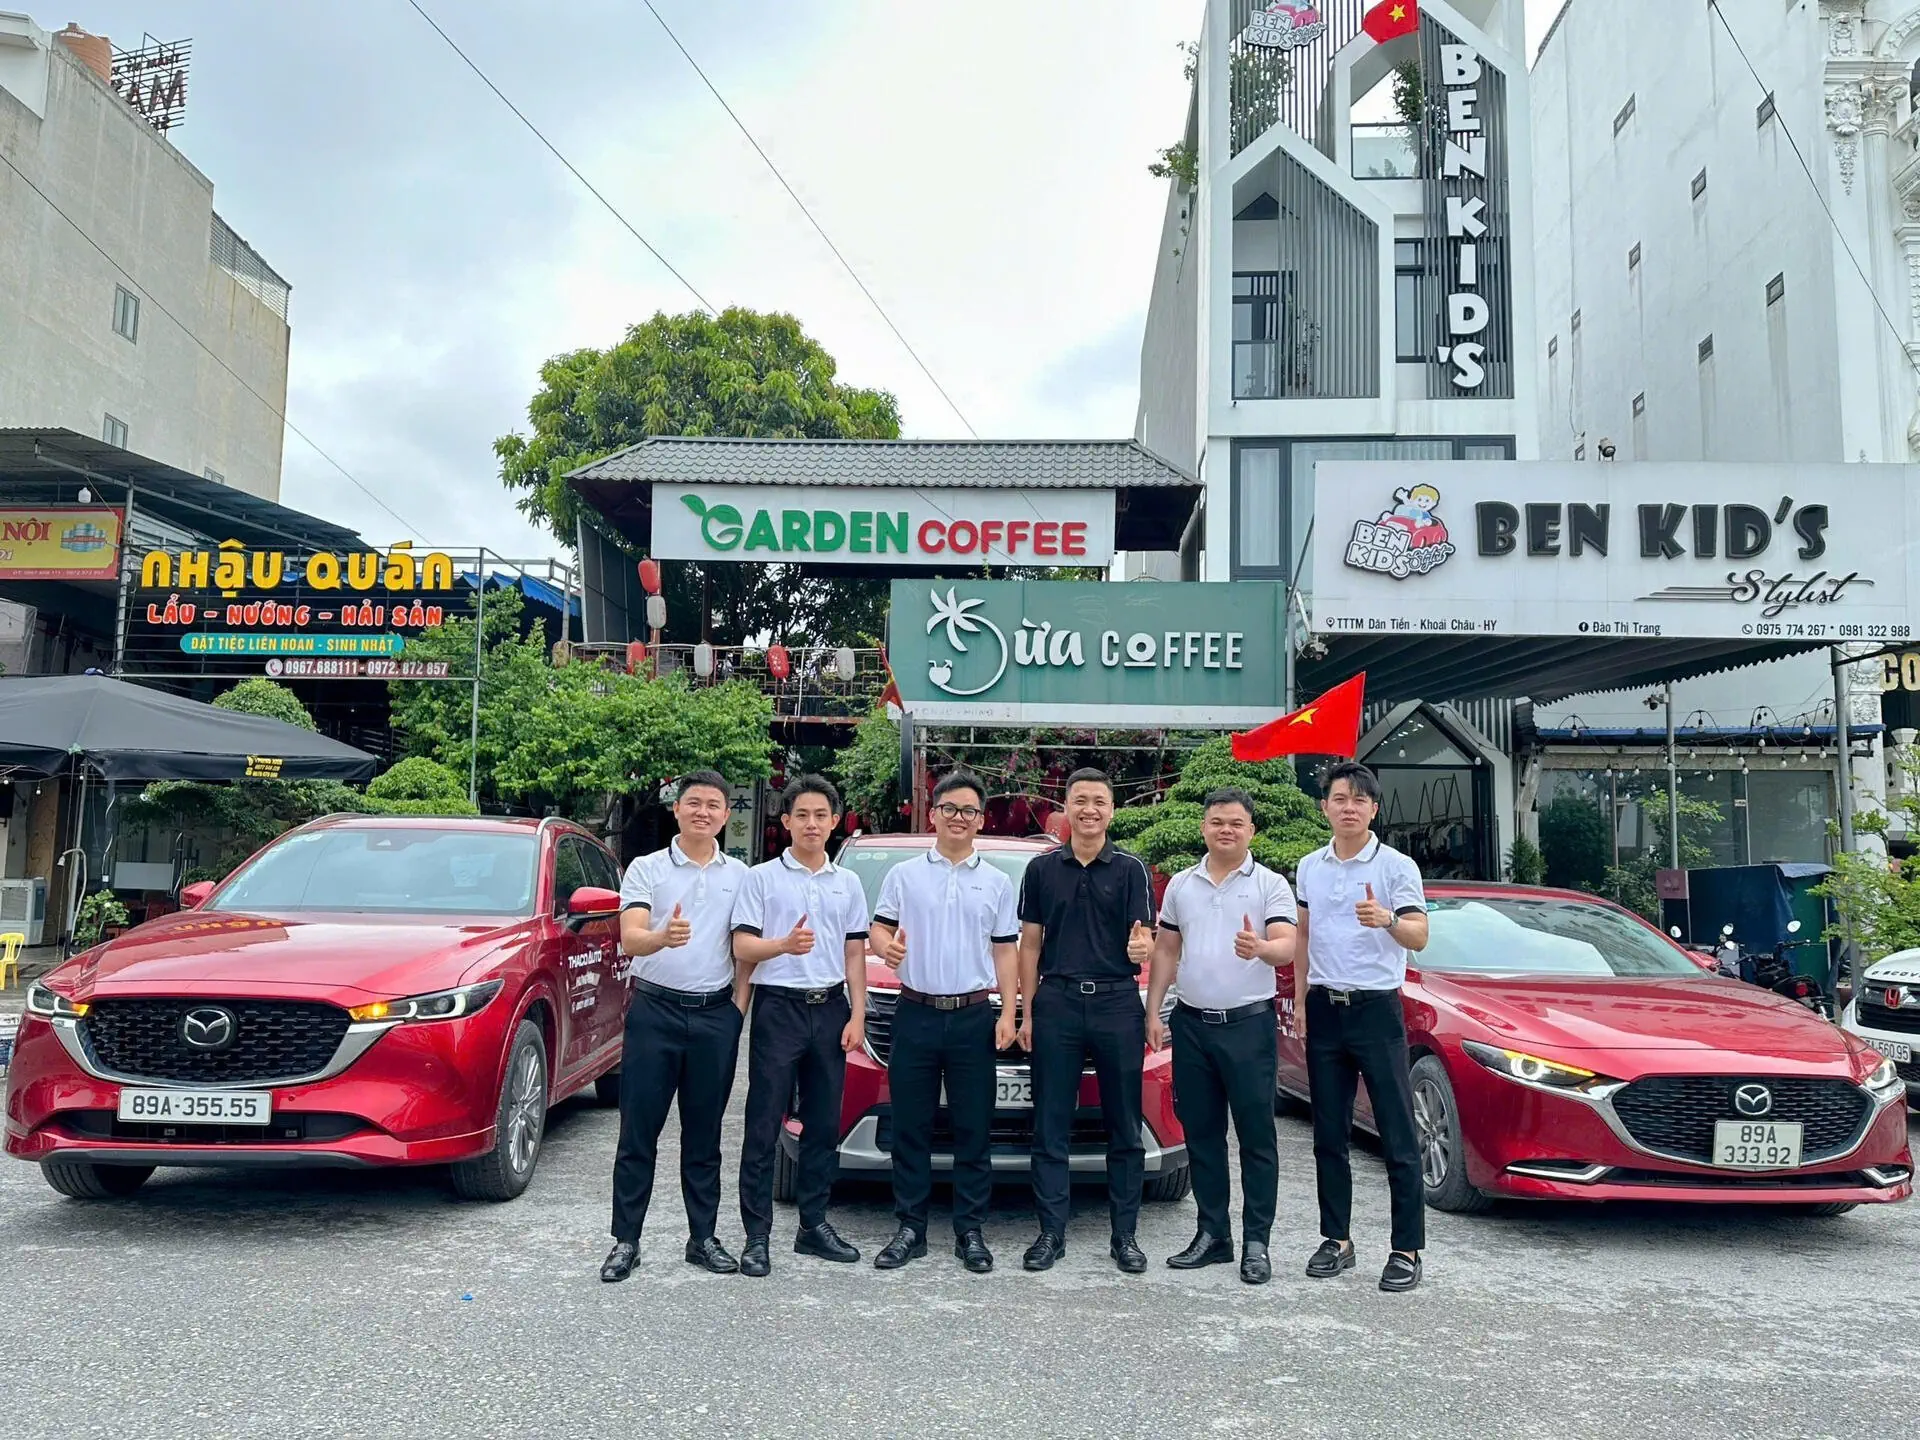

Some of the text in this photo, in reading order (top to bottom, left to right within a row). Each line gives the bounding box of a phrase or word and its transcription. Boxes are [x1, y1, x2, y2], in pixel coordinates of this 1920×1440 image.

[1252, 11, 1291, 32] BEN
[1440, 43, 1487, 180] BEN
[2, 517, 53, 546] NỘI
[680, 494, 1088, 555] GARDEN COFFEE
[1475, 495, 1829, 560] BEN KID'S
[1356, 523, 1411, 554] BEN
[1347, 542, 1411, 576] KID'S
[1726, 569, 1876, 619] Stylist
[147, 593, 196, 625] LẨU
[341, 599, 384, 626] HẢI
[391, 599, 443, 627] SẢN
[1337, 617, 1364, 630] TTTM
[1483, 619, 1498, 631] HY
[1614, 621, 1629, 635] Thị
[1633, 622, 1662, 636] Trang
[1756, 623, 1781, 635] 0975
[1786, 623, 1804, 636] 774
[1807, 624, 1826, 636] 267
[1839, 624, 1863, 637] 0981
[1867, 625, 1887, 637] 322
[1890, 625, 1911, 637] 988
[280, 637, 314, 651] HOAN
[326, 638, 357, 651] SINH
[361, 636, 394, 654] NHẬT
[1101, 630, 1244, 669] COFFEE
[426, 661, 448, 676] 857
[132, 1095, 257, 1118] 89A-355.55
[1740, 1125, 1777, 1144] 89A
[1723, 1145, 1791, 1165] 333.92
